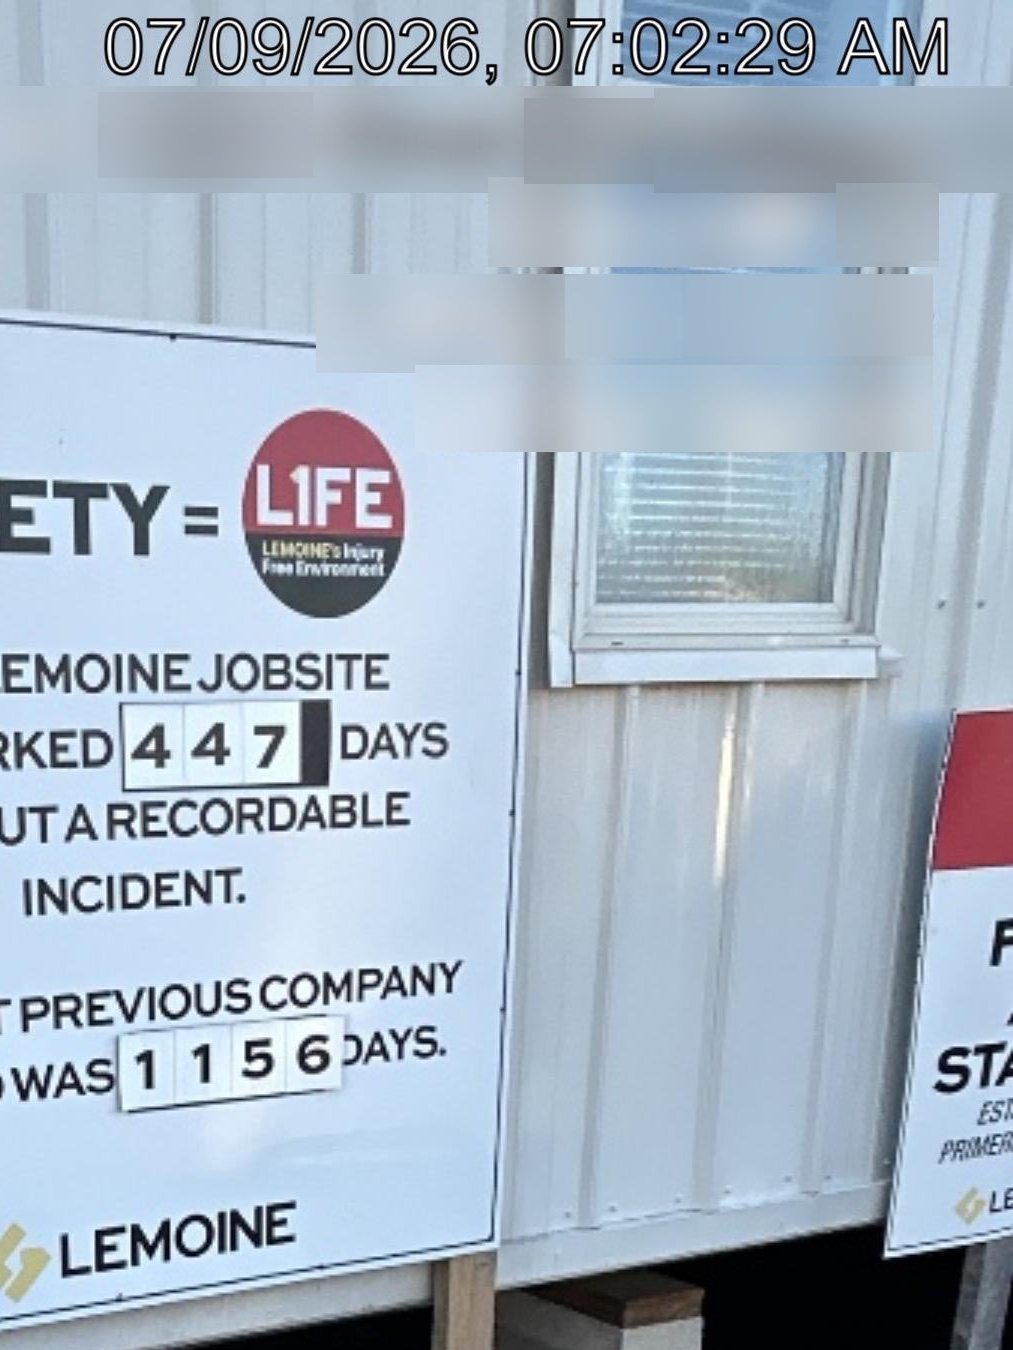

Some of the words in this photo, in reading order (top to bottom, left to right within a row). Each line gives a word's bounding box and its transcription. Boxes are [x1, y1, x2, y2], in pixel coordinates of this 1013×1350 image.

[256, 464, 393, 528] L1FE
[262, 540, 341, 559] LEMOINE's
[343, 542, 385, 561] Injury
[197, 653, 389, 693] JOBSITE
[131, 723, 286, 768] 447
[341, 722, 449, 760] DAYS
[65, 804, 98, 843] A
[107, 792, 410, 840] RECORDABLE
[23, 867, 246, 916] INCIDENT.
[20, 978, 252, 1033] PREVIOUS
[260, 960, 463, 1011] COMPANY
[11, 1059, 115, 1101] WAS
[134, 1034, 332, 1089] 1156
[342, 1025, 446, 1066] DAYS.
[61, 1201, 296, 1278] LEMOINE
